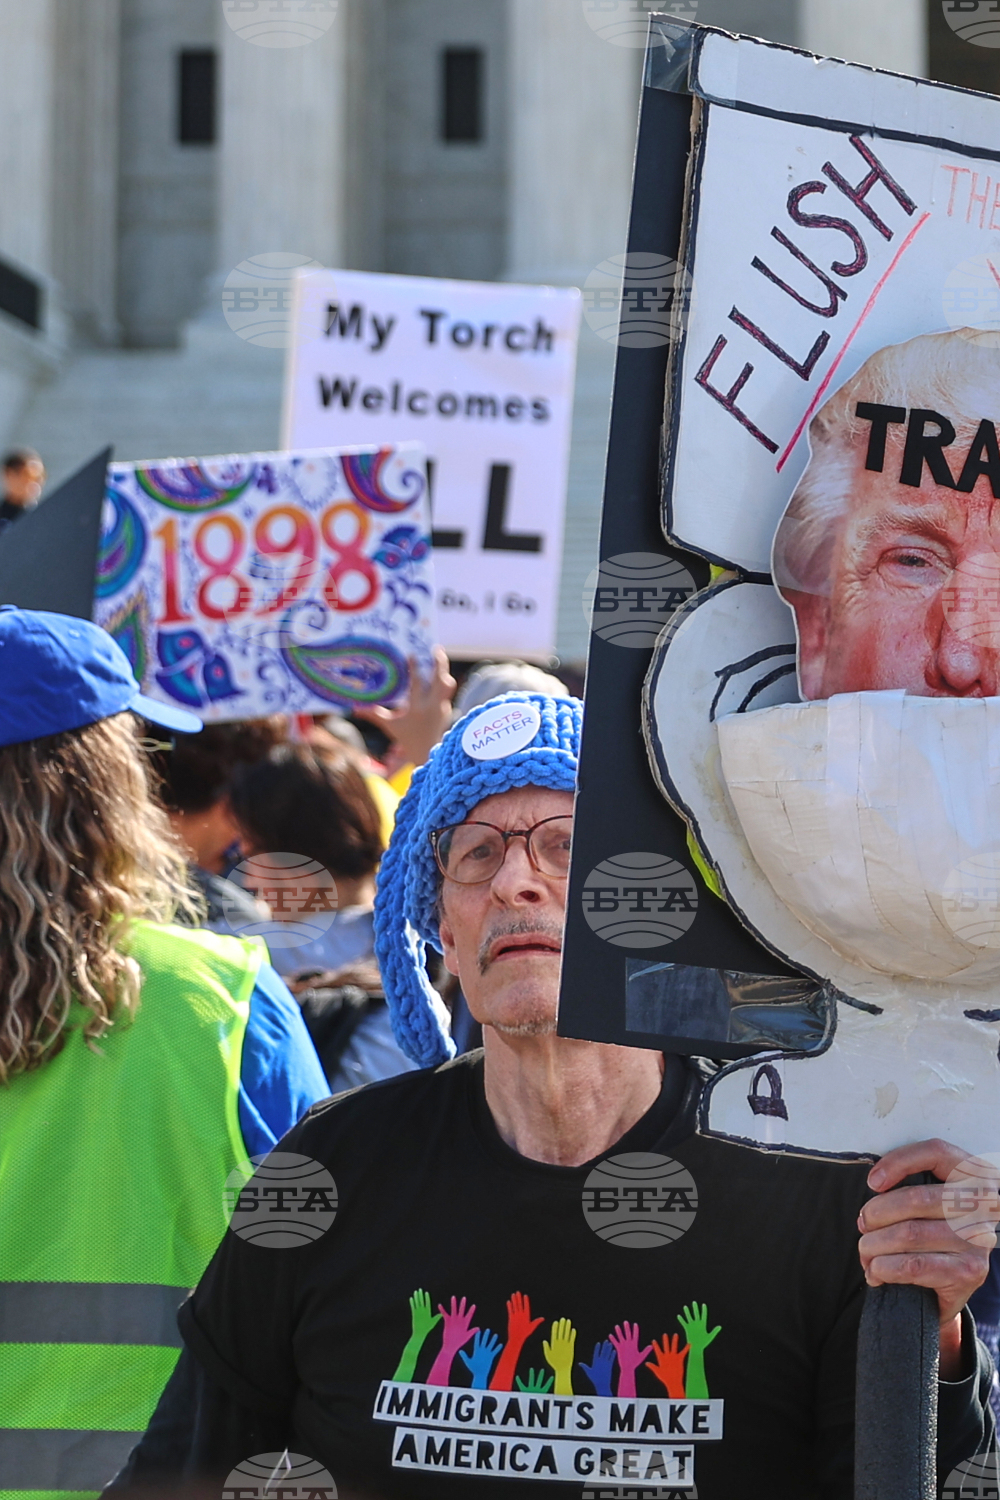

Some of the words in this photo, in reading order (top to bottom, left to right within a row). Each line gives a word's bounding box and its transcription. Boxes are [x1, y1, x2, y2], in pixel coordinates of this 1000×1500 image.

[694, 134, 918, 454] FLUSH
[326, 302, 396, 351] My
[418, 307, 554, 352] Torch
[317, 372, 549, 425] Welcomes
[153, 501, 382, 626] 1898
[471, 716, 534, 752] MATTER
[473, 710, 522, 739] FACTS
[376, 1385, 595, 1431] IMMIGRANTS
[609, 1402, 711, 1435] MAKE
[395, 1433, 558, 1475] AMERICA
[574, 1447, 692, 1481] GREAT
